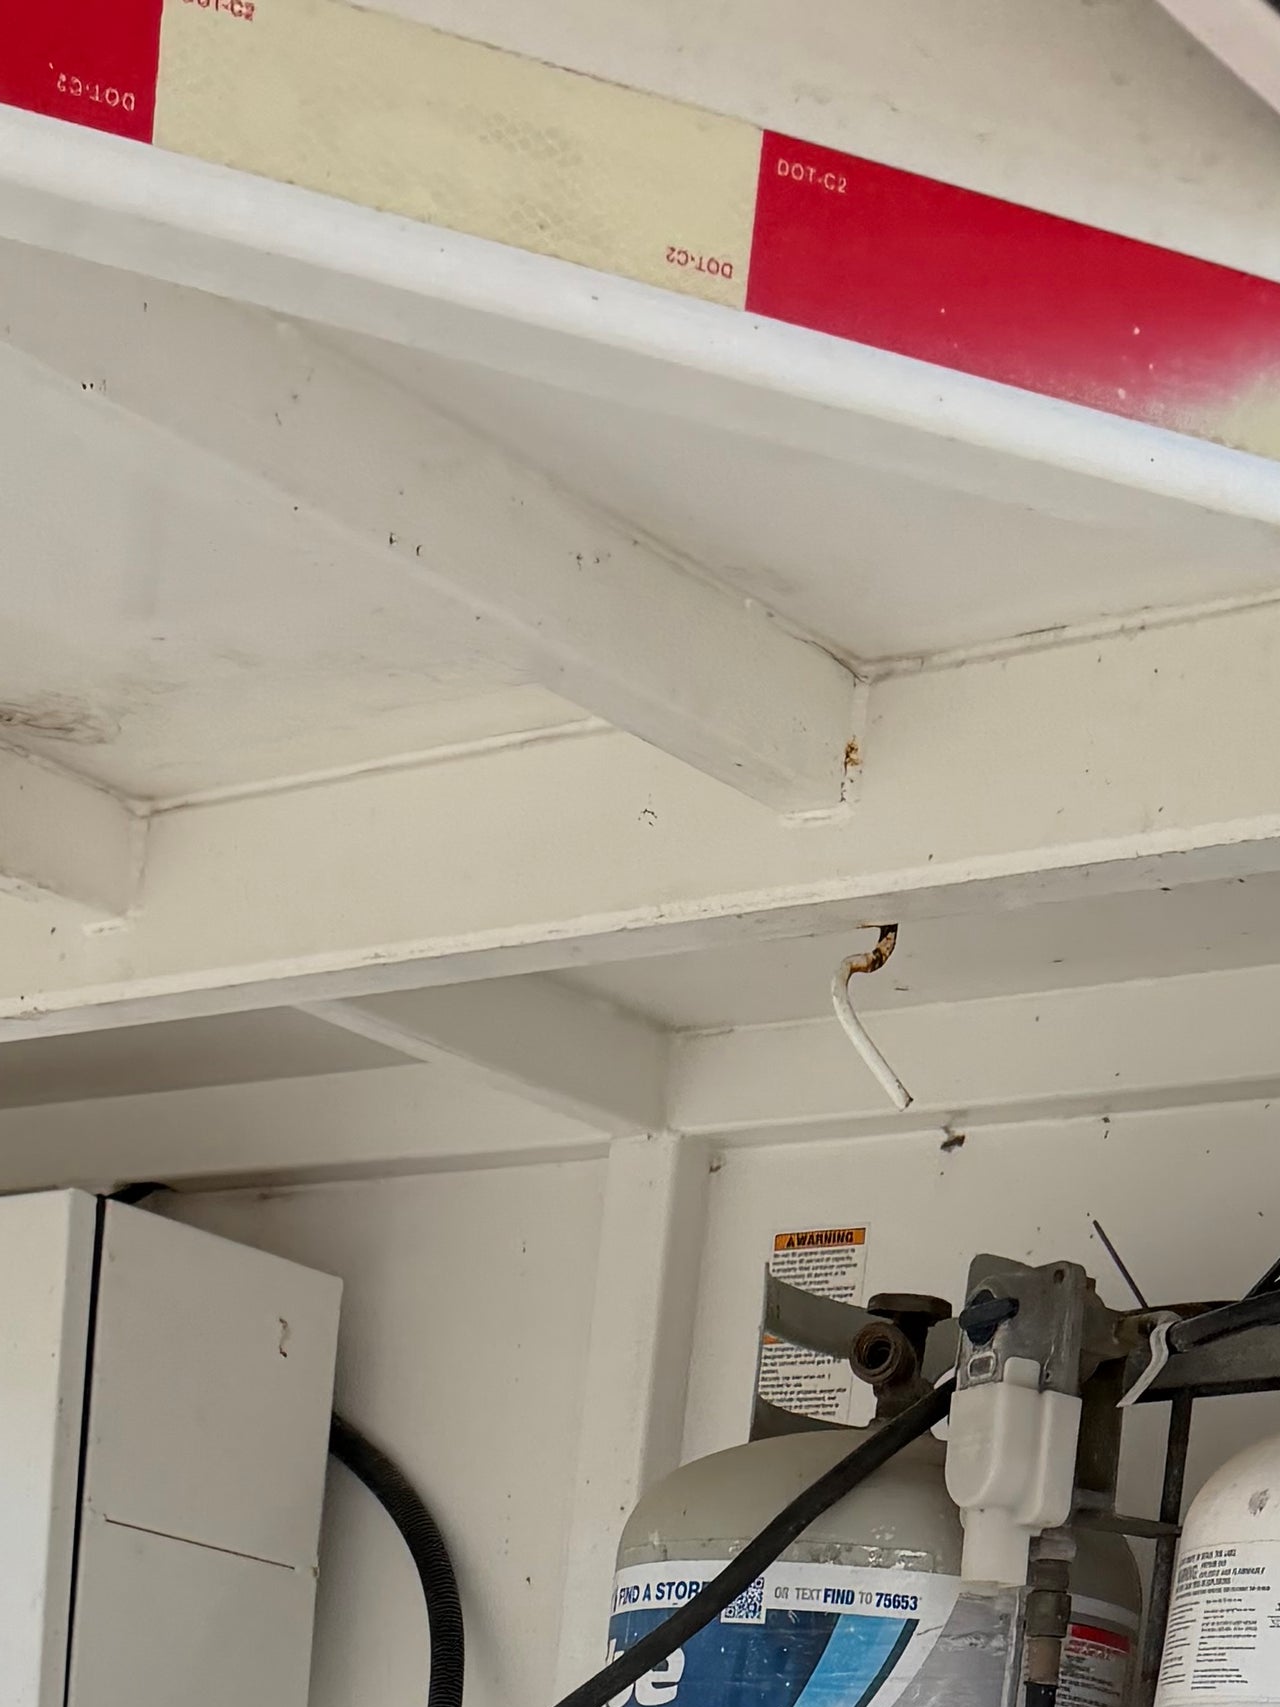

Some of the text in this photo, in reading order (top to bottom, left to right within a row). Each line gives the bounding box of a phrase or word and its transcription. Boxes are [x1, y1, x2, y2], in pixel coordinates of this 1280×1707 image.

[796, 1231, 854, 1247] WARNING
[618, 1585, 640, 1606] FIND
[642, 1583, 651, 1602] A
[774, 1587, 789, 1601] OR
[795, 1587, 822, 1602] TEXT
[823, 1588, 855, 1606] FIND
[859, 1591, 873, 1606] TO
